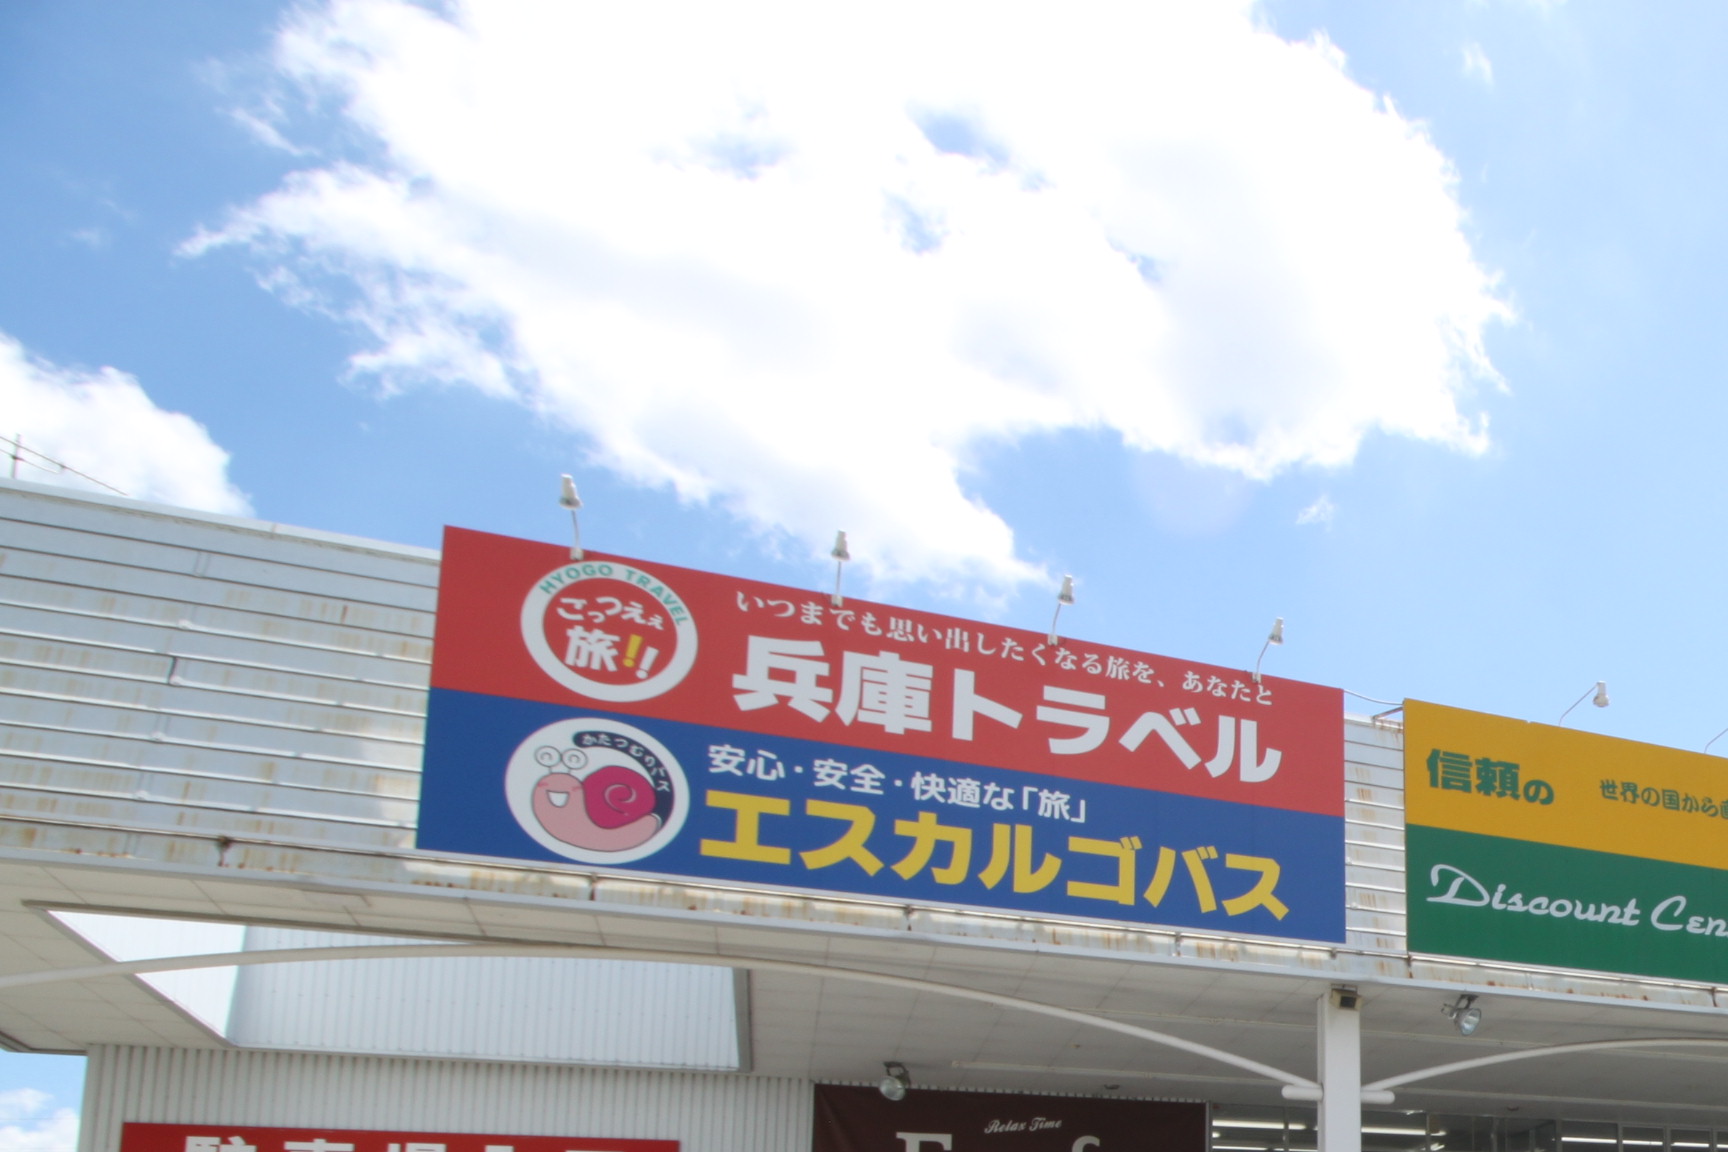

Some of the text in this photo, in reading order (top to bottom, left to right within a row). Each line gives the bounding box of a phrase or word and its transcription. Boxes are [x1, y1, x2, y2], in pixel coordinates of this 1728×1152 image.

[539, 563, 689, 626] HYOGO TRAVEL
[732, 634, 1283, 783] 兵庫トラベル
[581, 733, 671, 792] かたつむりバス
[1425, 747, 1555, 806] 信頼の
[700, 789, 1290, 921] エスカルゴバス
[1426, 863, 1641, 927] Discount
[983, 1117, 1063, 1135] Relax Time
